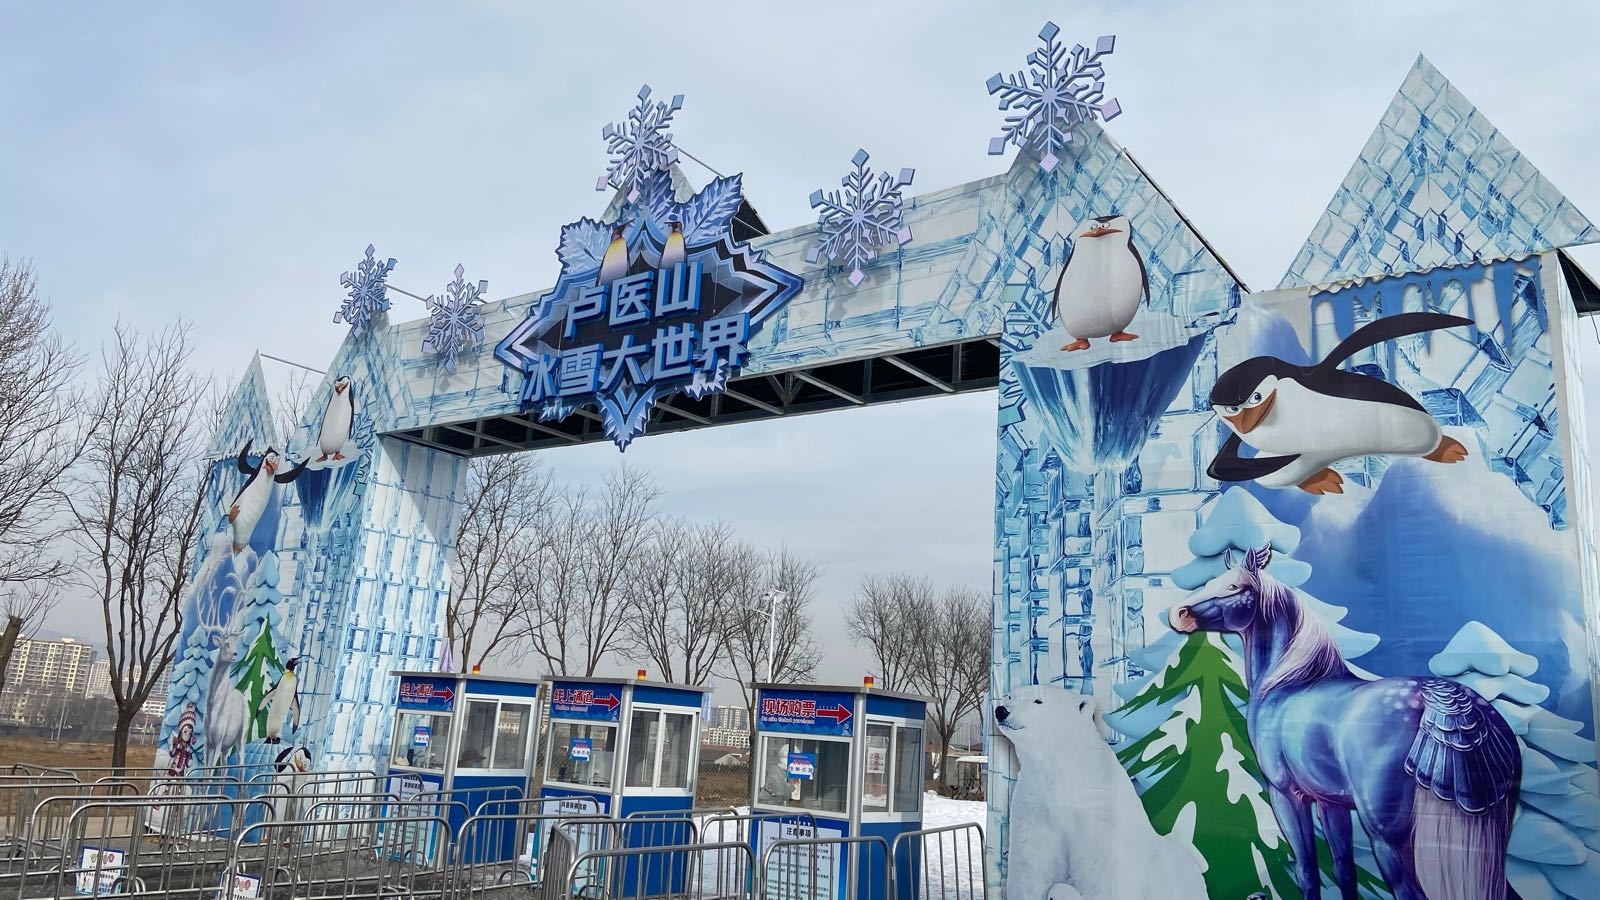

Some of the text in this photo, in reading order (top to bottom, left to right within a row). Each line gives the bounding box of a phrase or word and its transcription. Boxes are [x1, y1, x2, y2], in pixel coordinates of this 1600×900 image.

[563, 260, 702, 341] 卢医山
[517, 312, 749, 404] 冰雪大世界
[400, 683, 433, 697] 线上通道
[553, 689, 594, 705] 线上通道
[761, 698, 816, 719] 现场购票
[786, 826, 813, 838] 注意事项
